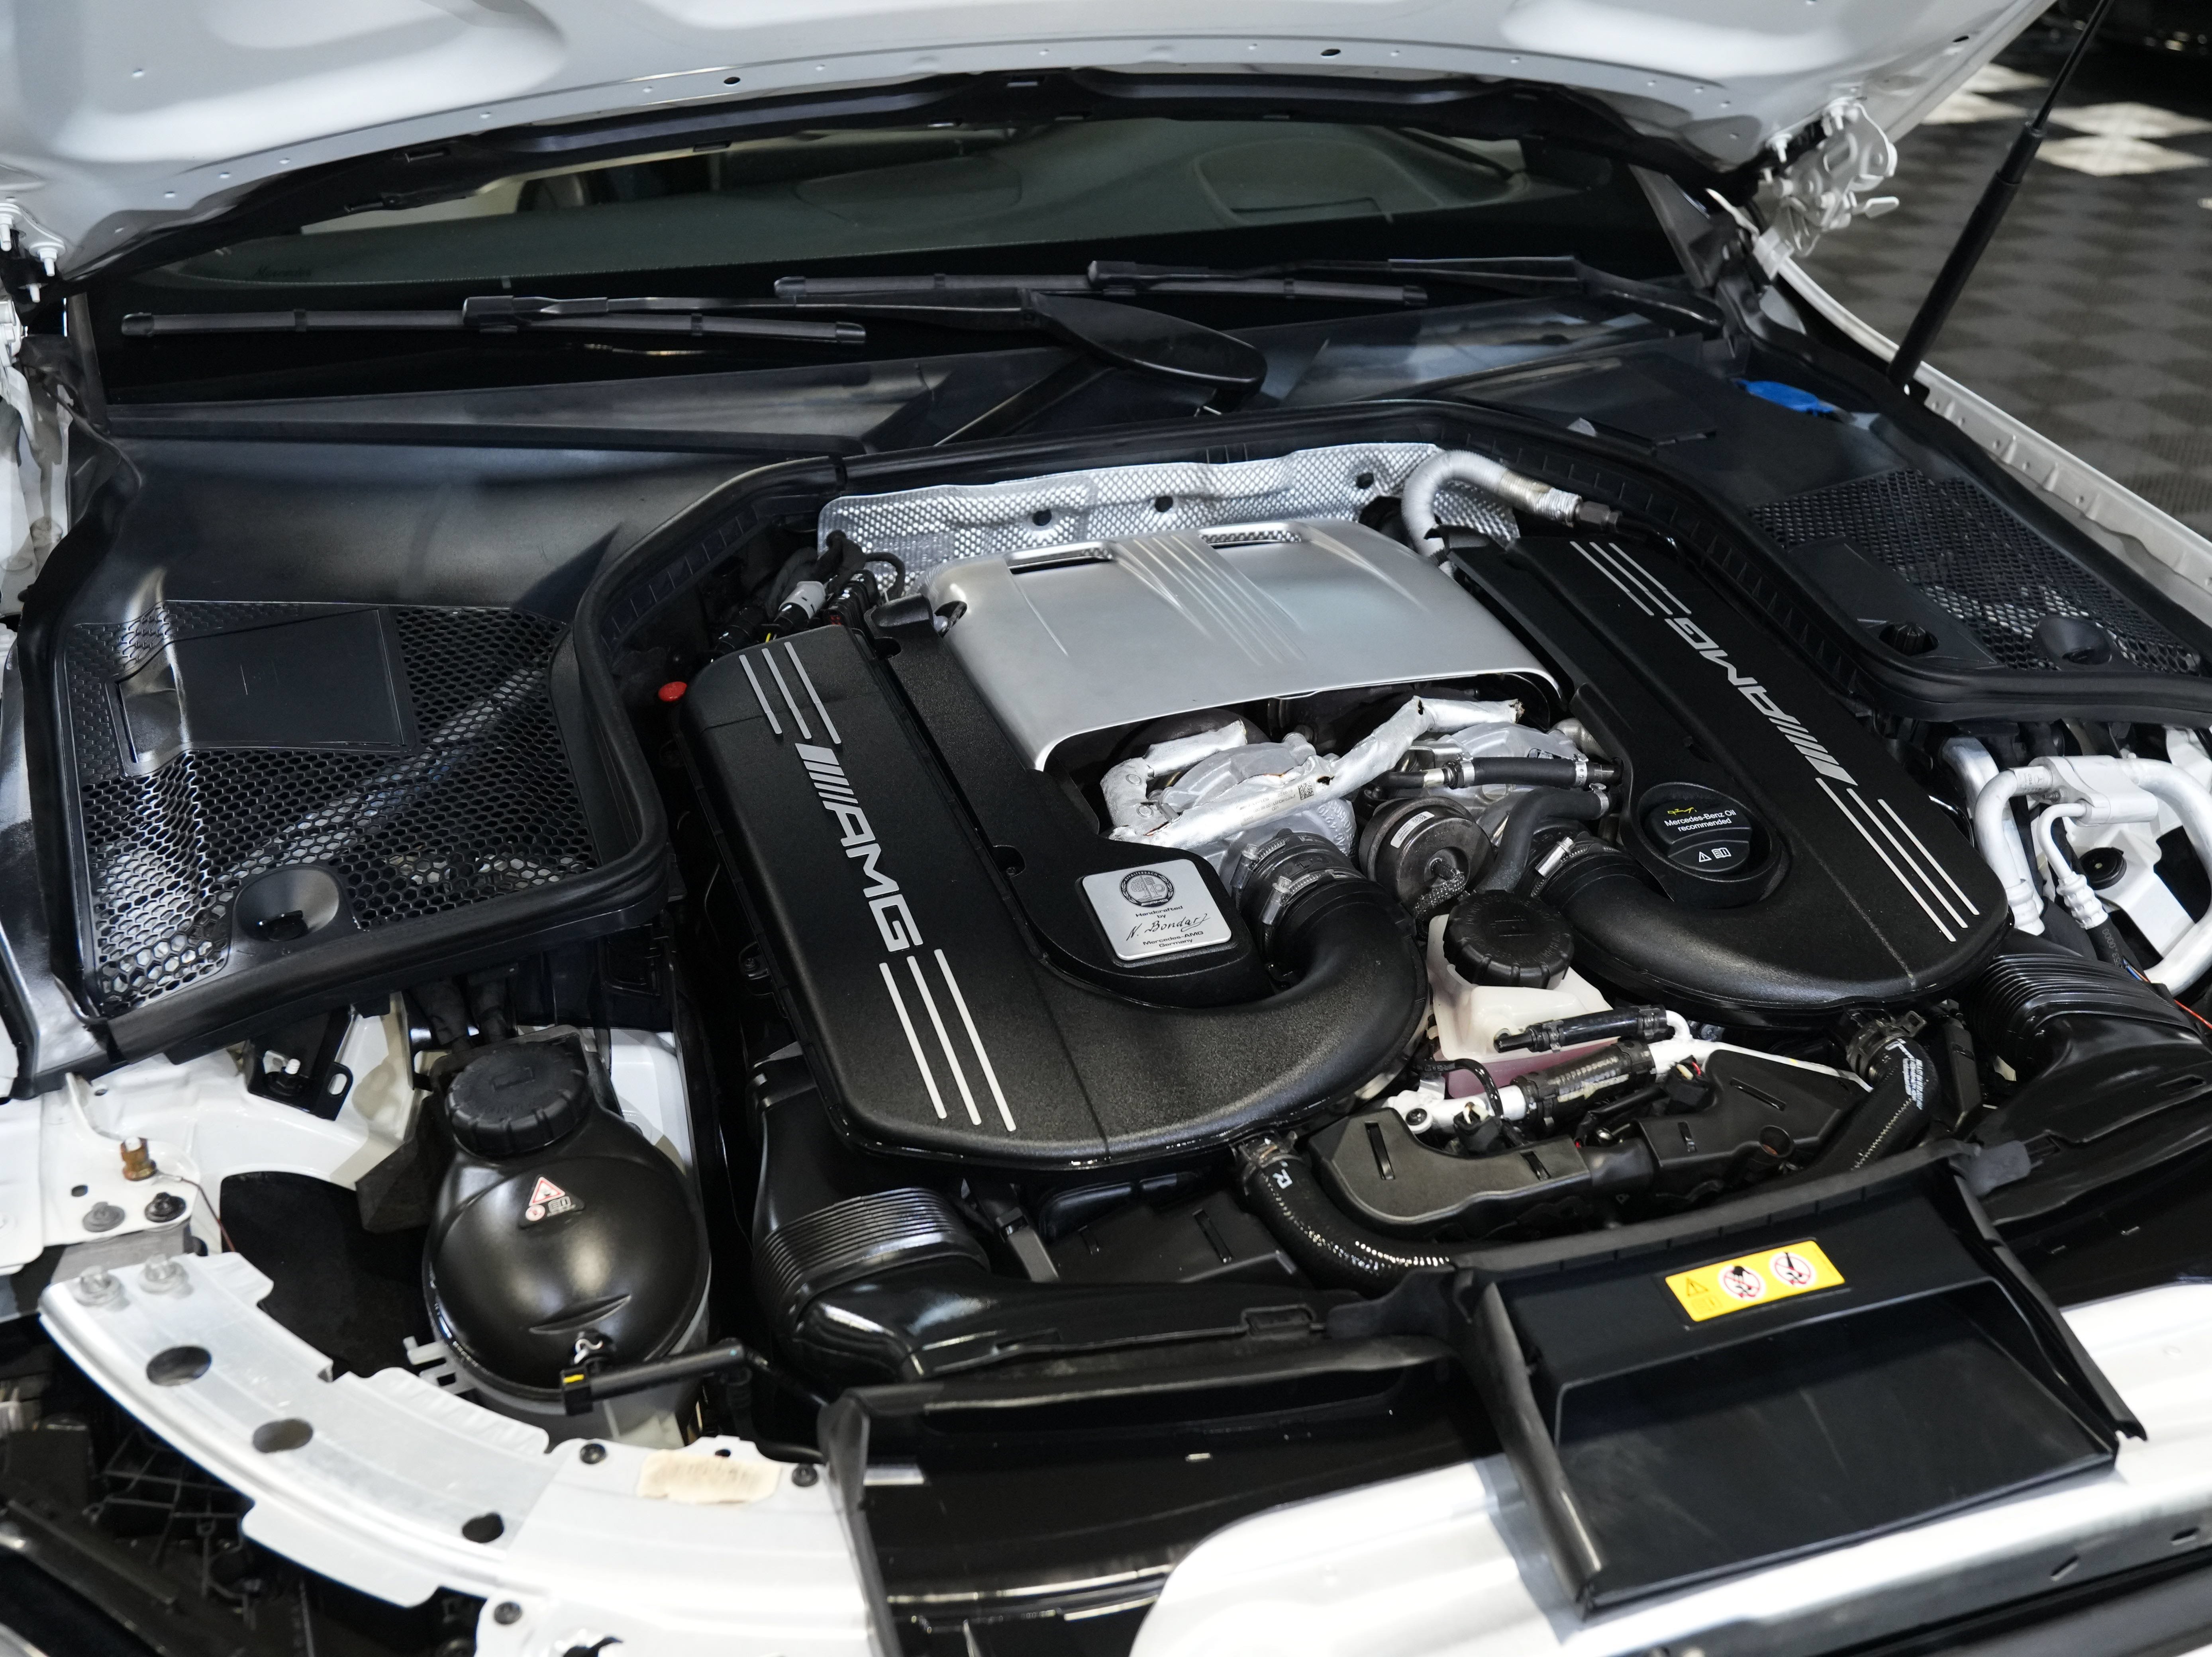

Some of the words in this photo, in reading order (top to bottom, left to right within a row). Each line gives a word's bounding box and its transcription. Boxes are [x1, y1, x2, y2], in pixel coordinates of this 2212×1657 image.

[1664, 811, 1724, 827] Mercedes-Benz
[1677, 817, 1732, 832] recommended
[822, 801, 924, 952] AMG
[1135, 905, 1183, 917] Handcrafted
[1143, 930, 1204, 946] Mercedes-AMG
[1159, 938, 1193, 948] Germany
